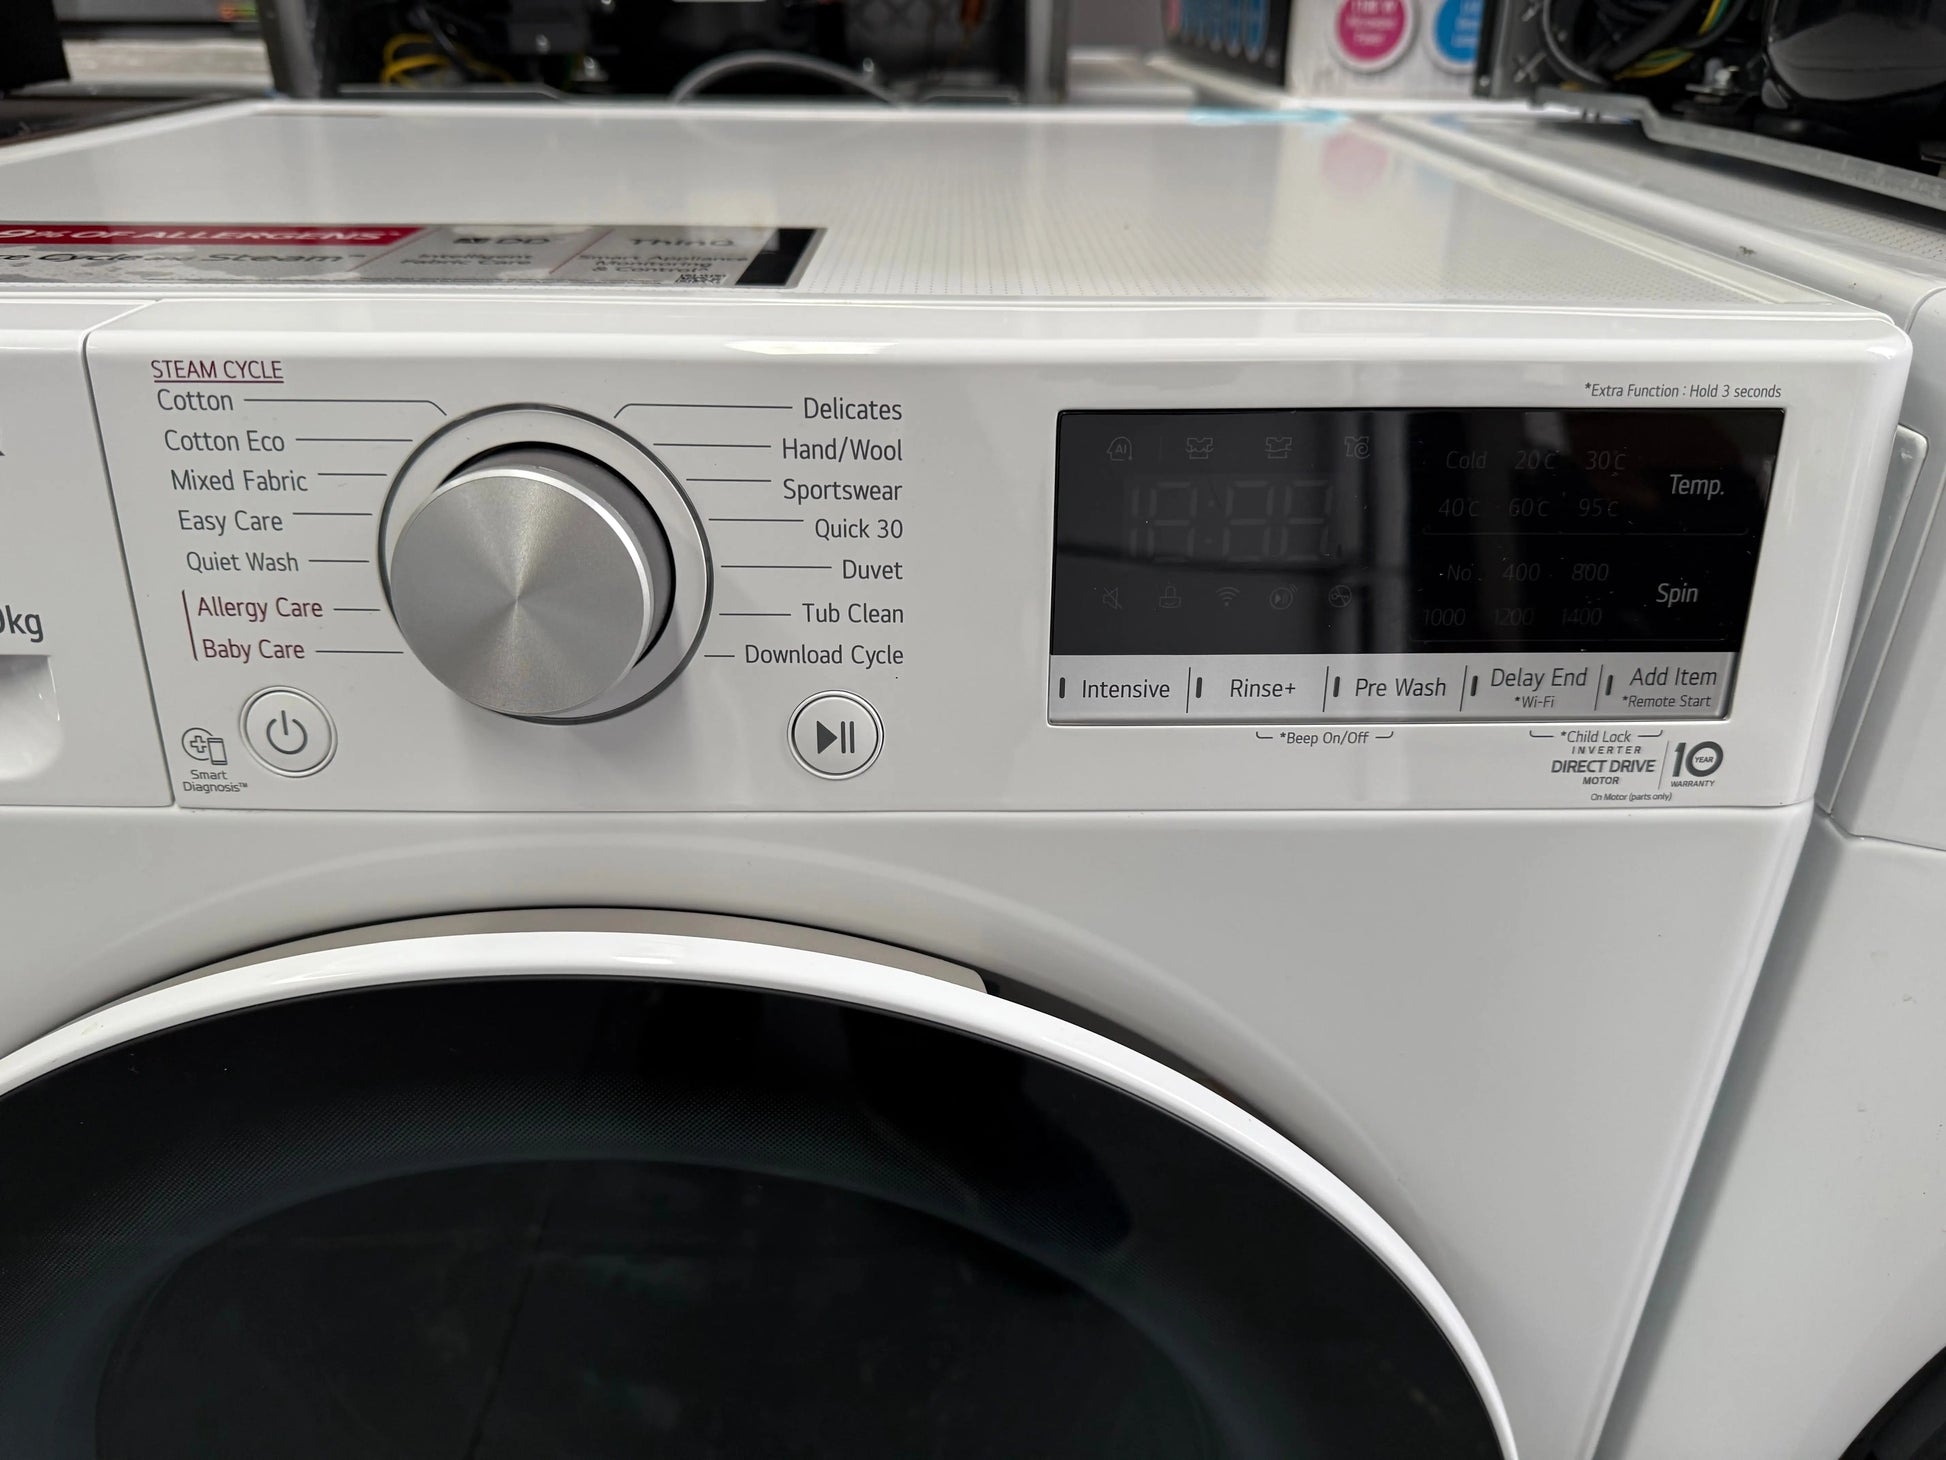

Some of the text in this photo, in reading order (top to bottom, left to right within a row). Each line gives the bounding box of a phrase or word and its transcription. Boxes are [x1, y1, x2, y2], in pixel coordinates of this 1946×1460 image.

[151, 360, 284, 379] STEAM CYCLE
[157, 388, 235, 412] Cotton
[1627, 383, 1680, 398] Function
[1689, 384, 1719, 398] Hold
[1721, 384, 1731, 398] 3
[1733, 384, 1782, 398] seconds
[803, 396, 903, 421] Delicates
[164, 429, 286, 452] Cotton Eco
[782, 436, 903, 463] Hand/Wool
[1446, 449, 1489, 470] Cold
[170, 469, 309, 492] Mixed Fabric
[1669, 474, 1725, 500] Temp.
[782, 478, 903, 505] Sportswear
[178, 509, 284, 537] Easy Care
[814, 518, 904, 542] Quick 30
[186, 551, 299, 574] Quiet Wash
[842, 559, 904, 580] Duvet
[1656, 583, 1699, 608] Spin
[197, 596, 324, 623] Allergy Care
[801, 602, 905, 624] Tub Clean
[202, 638, 306, 664] Baby Care
[745, 644, 904, 669] Download Cycle
[1490, 667, 1589, 692] Delay End
[1628, 666, 1718, 686] Add Item
[1081, 679, 1170, 698] Intensive
[1229, 678, 1296, 698] Rinse+
[1355, 677, 1447, 697] Pre Wash
[1680, 694, 1712, 708] Start
[1322, 731, 1369, 745] On/Off
[1602, 730, 1632, 743] Lock
[1571, 746, 1642, 755] INVERTER
[1672, 740, 1725, 778] 10
[1694, 755, 1715, 764] YEAR
[190, 769, 228, 780] Smart
[1550, 759, 1657, 773] DIRECT DRIVE
[1582, 776, 1620, 785] MOTOR
[1670, 780, 1716, 788] WARRANTY
[1590, 792, 1673, 802] On Motor (parts only)
